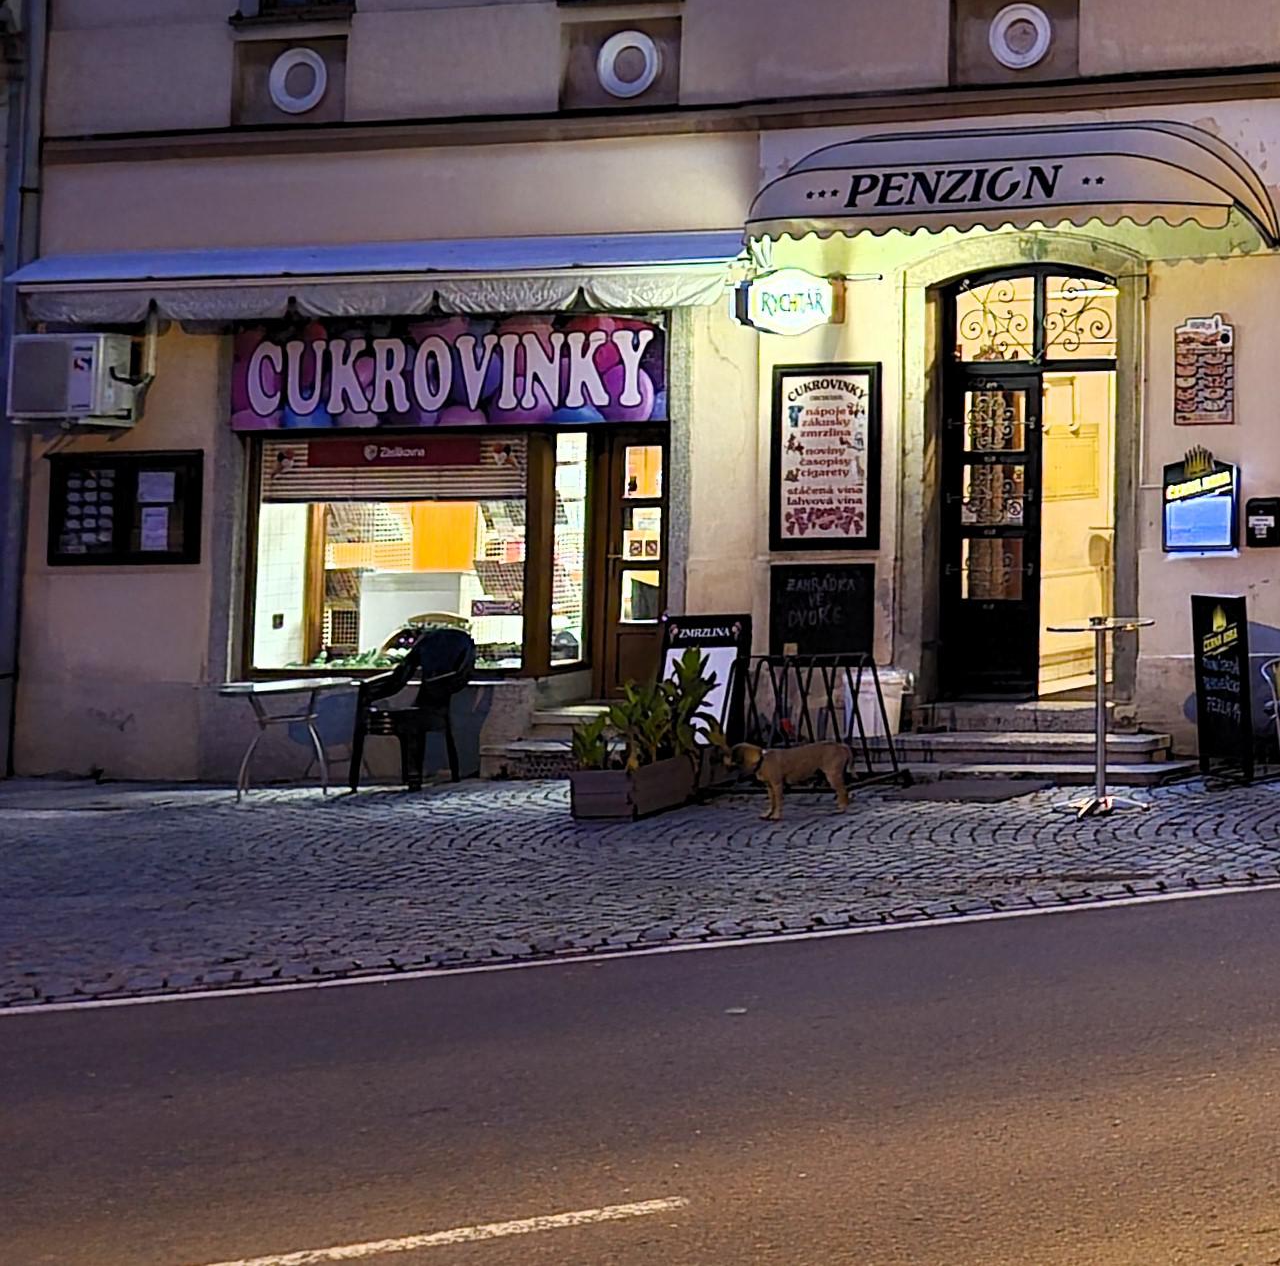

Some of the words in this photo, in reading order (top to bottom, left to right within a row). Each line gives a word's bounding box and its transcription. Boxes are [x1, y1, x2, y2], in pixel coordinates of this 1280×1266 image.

[843, 164, 1063, 208] PENZION
[247, 329, 654, 416] CUKROVINKY
[787, 378, 868, 402] CUKROVINKY
[805, 405, 847, 421] nápoje
[801, 417, 851, 429] zákusky
[800, 428, 852, 438] zmrzlina
[805, 446, 847, 457] noviny
[799, 456, 852, 468] časopisy
[800, 467, 851, 478] cigarety
[787, 485, 834, 495] stáčená
[837, 485, 864, 495] vína
[837, 496, 863, 506] vína
[679, 626, 730, 639] ZMRZLINA
